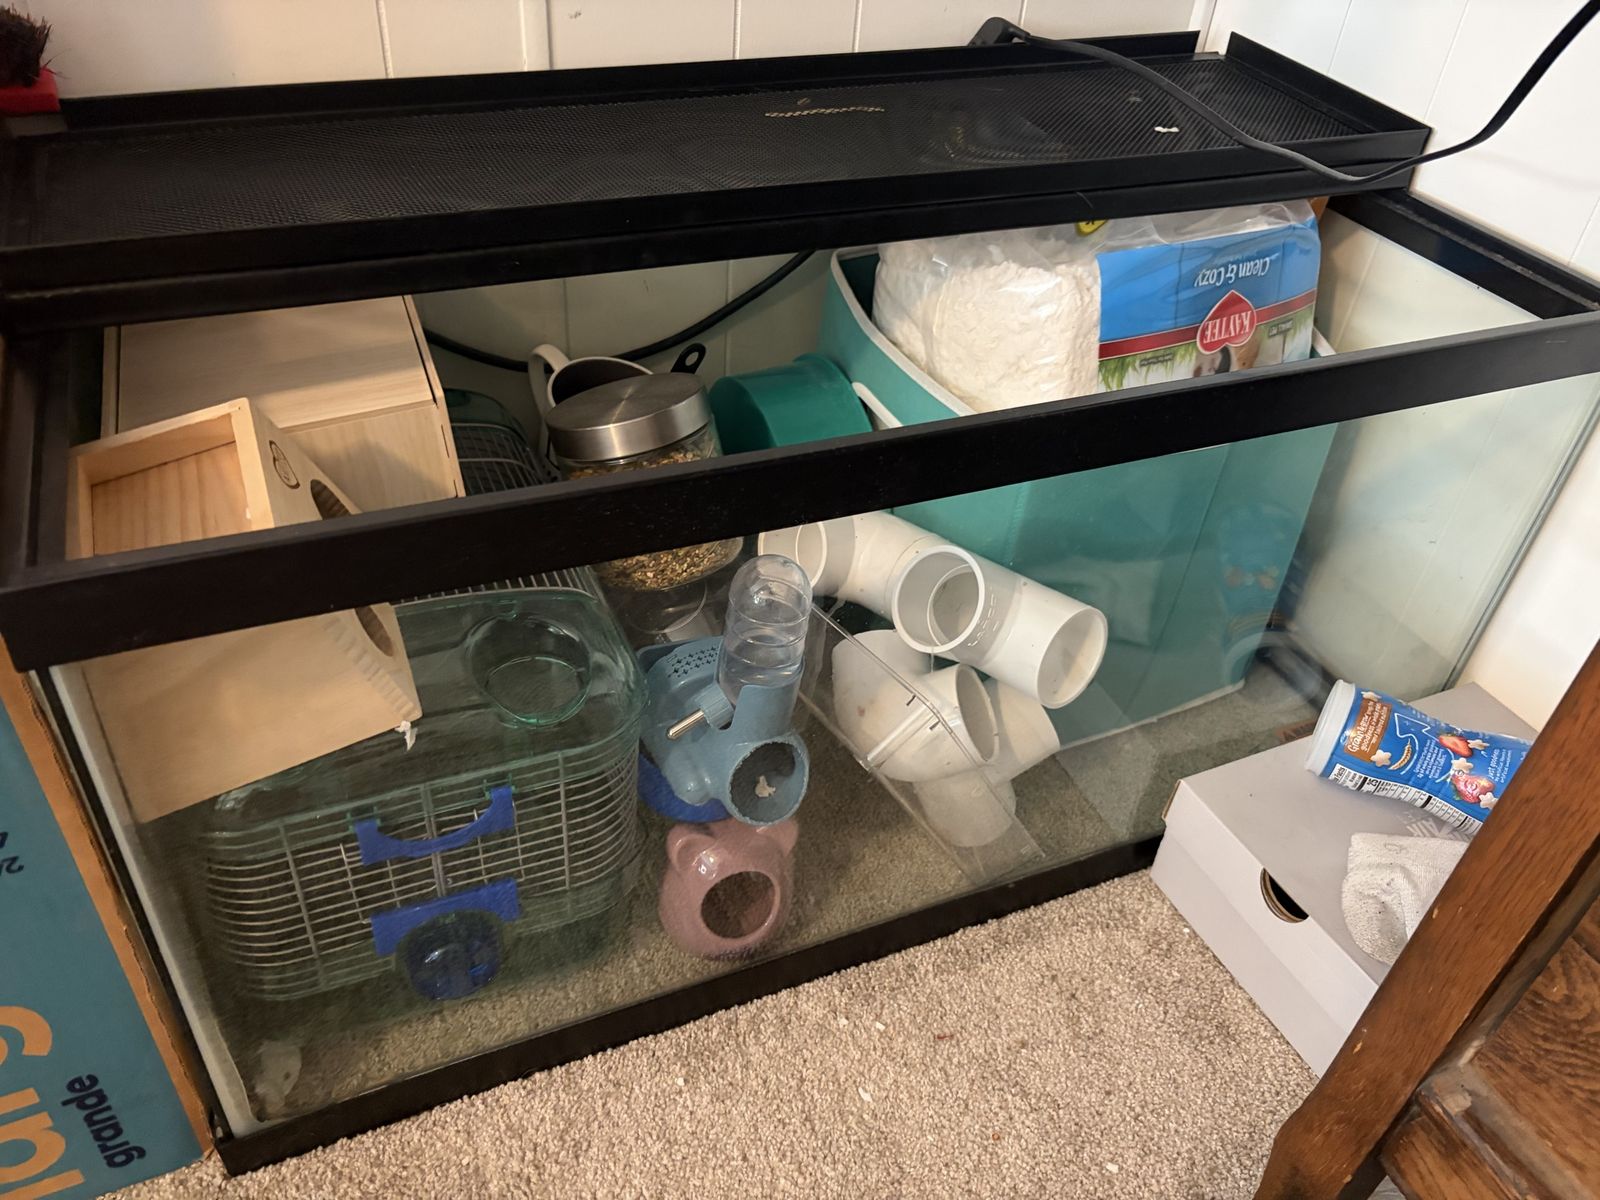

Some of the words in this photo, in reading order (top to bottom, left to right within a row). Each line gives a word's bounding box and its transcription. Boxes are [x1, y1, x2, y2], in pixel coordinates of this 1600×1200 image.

[1193, 266, 1225, 288] Cozy
[1225, 263, 1238, 284] &
[1238, 257, 1271, 278] Clean
[1202, 310, 1252, 344] KAYTEE
[1347, 730, 1364, 752] Grain
[61, 1073, 146, 1169] grande
